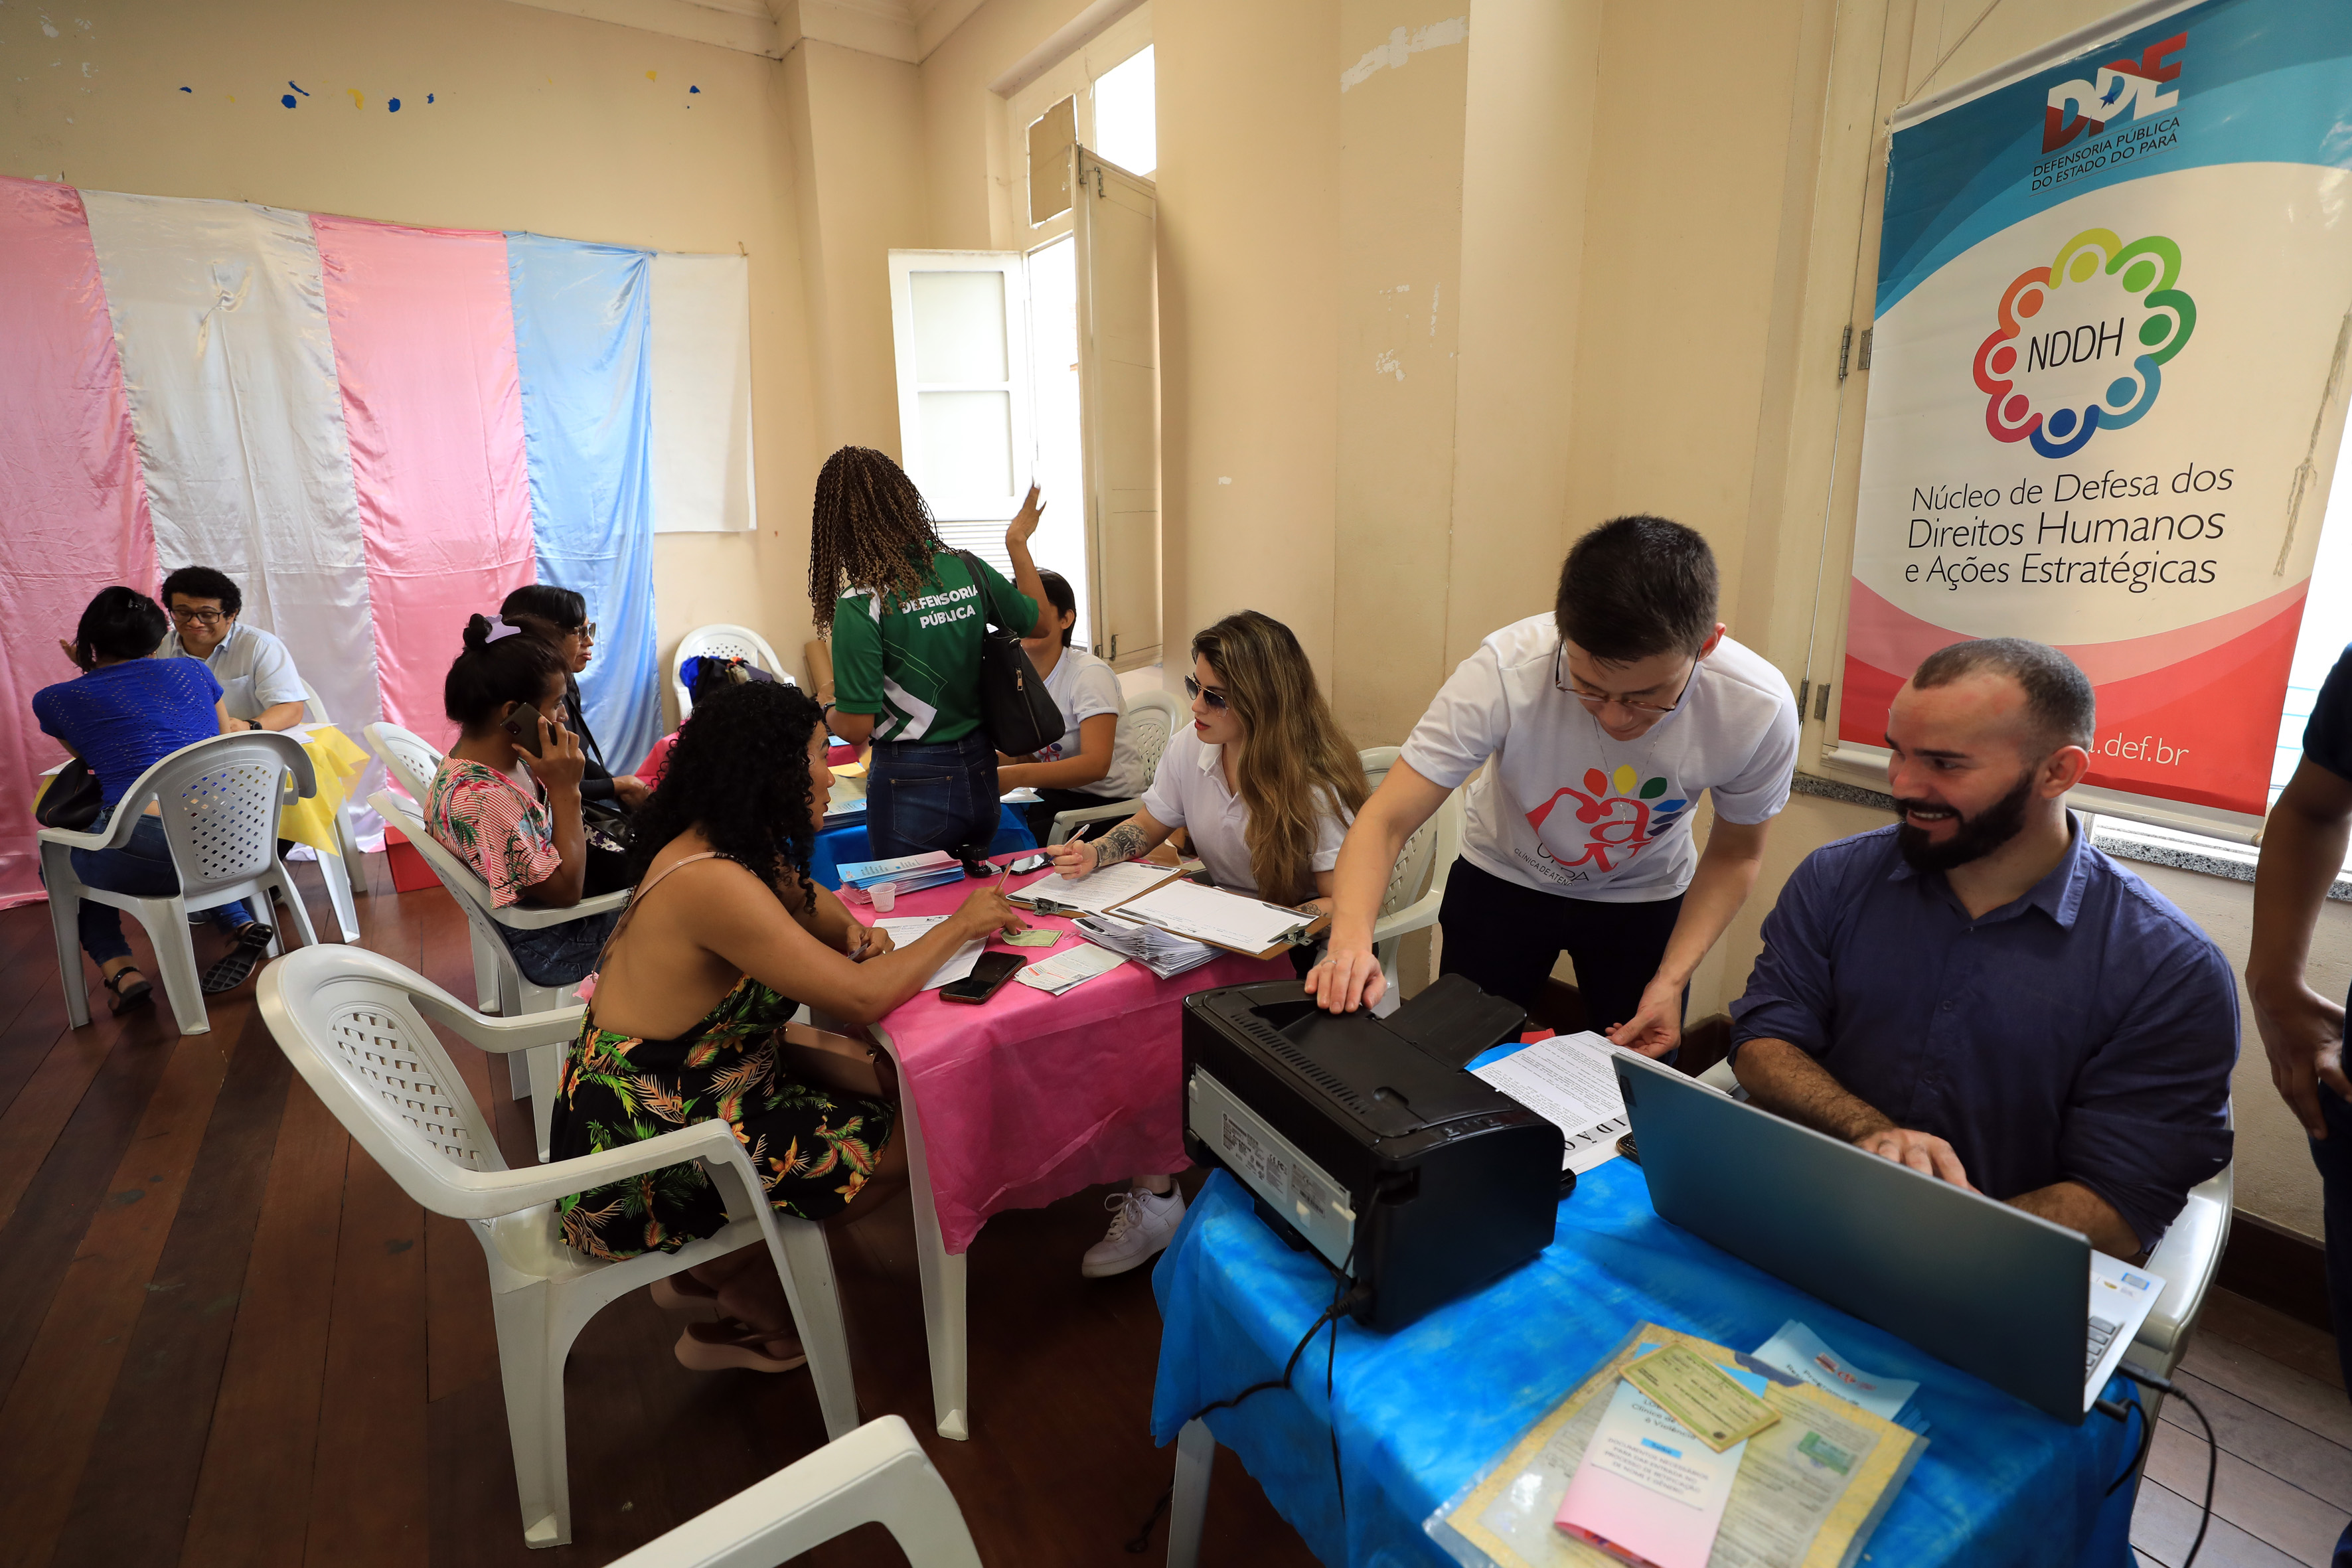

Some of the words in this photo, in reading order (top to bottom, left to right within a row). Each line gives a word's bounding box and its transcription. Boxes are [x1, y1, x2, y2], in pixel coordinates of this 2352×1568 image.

[2041, 31, 2189, 155] DPE
[2031, 175, 2053, 191] DO
[2055, 156, 2106, 183] ESTADO
[2110, 147, 2135, 163] DO
[2139, 128, 2178, 154] PARÁ
[2033, 139, 2112, 177] DEFENSORIA
[2116, 116, 2180, 147] PÚBLICA
[2027, 317, 2126, 373] NDDH
[1912, 481, 2001, 512] Núcleo
[2009, 477, 2043, 505] de
[2053, 469, 2159, 503] Defesa
[2170, 462, 2234, 494] dos
[1908, 515, 2024, 549] Direitos
[2037, 510, 2226, 545] Humanos
[1905, 563, 1919, 584] e
[1926, 555, 2010, 591] Ações
[2021, 550, 2217, 594] Estratégicas
[902, 584, 979, 614] DEFENSORIA
[919, 604, 976, 629] PÚBLICA
[1514, 847, 1539, 870] CLÍNICA
[1539, 863, 1551, 876] DE
